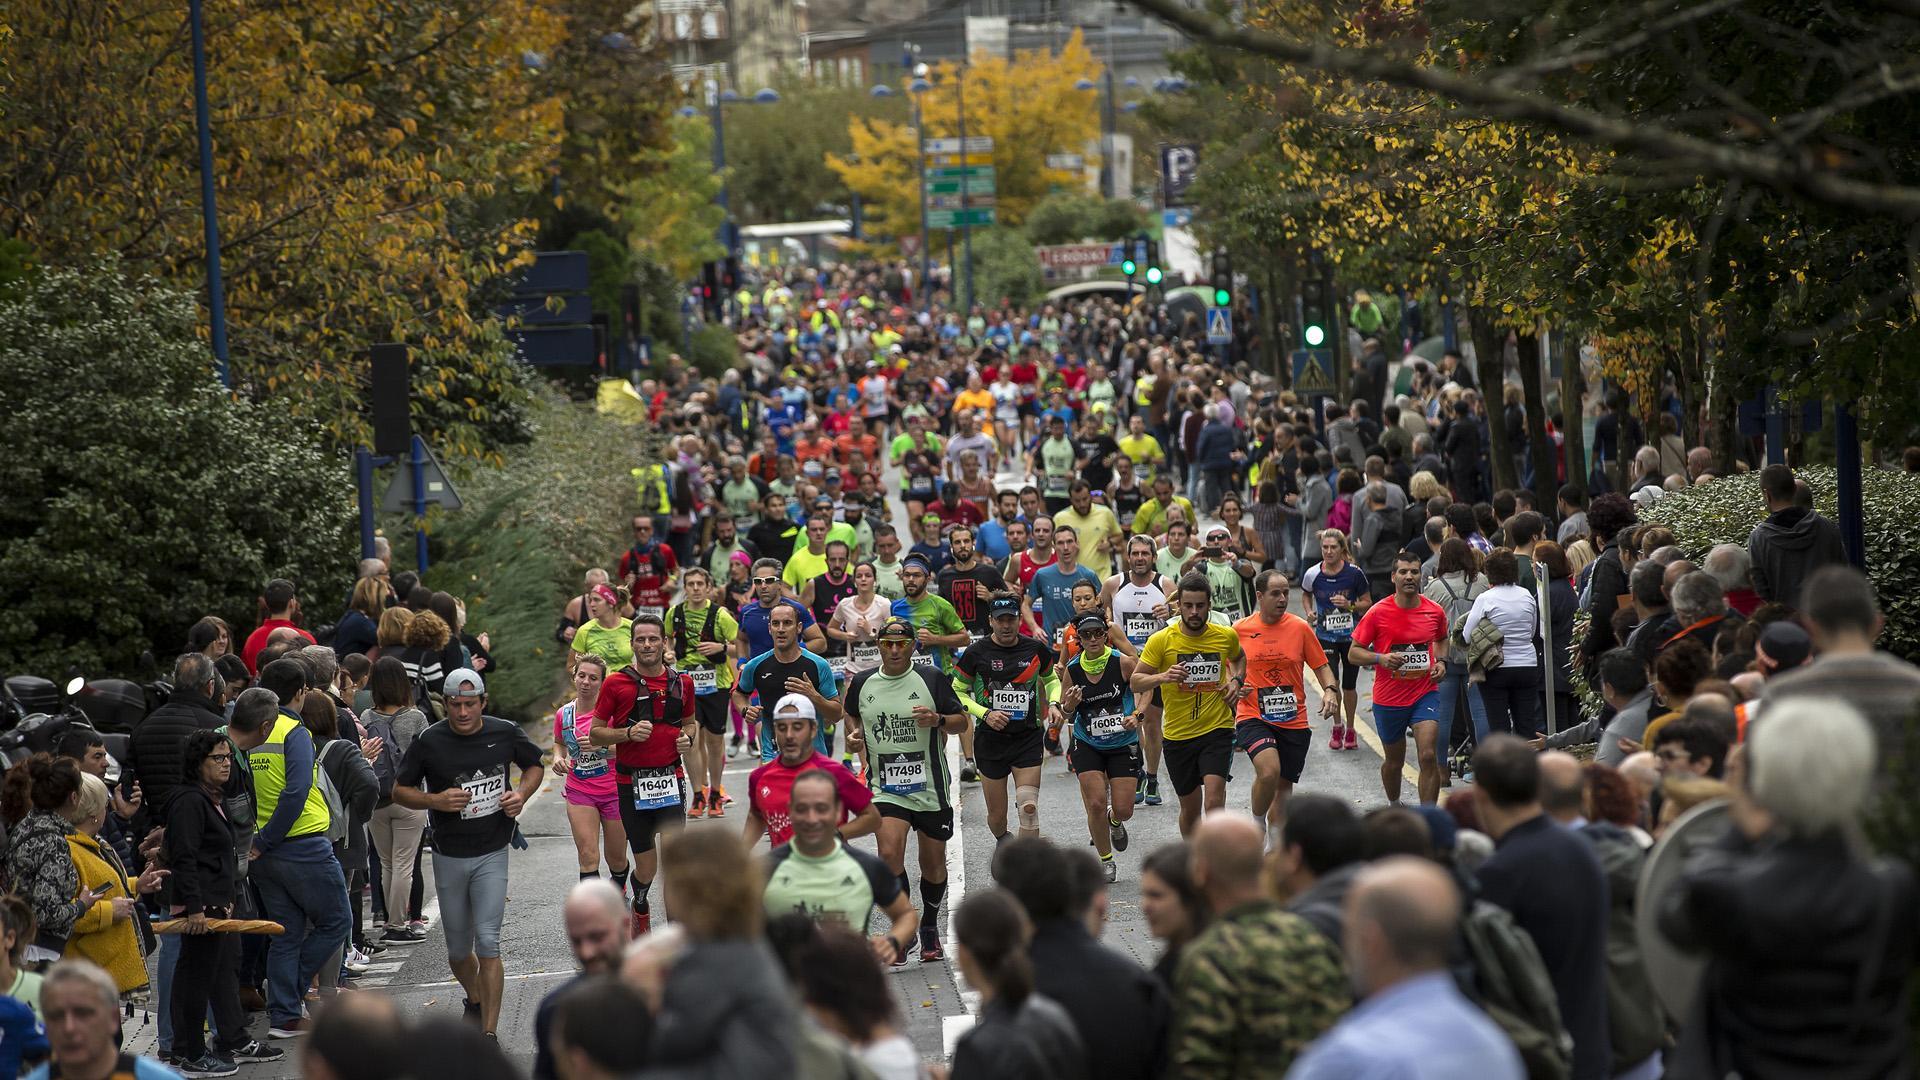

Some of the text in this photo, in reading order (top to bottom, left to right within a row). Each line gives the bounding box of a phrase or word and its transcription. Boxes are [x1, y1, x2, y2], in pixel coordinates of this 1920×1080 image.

[1167, 147, 1196, 183] P
[955, 592, 973, 622] 36
[1129, 621, 1155, 630] 15411
[855, 648, 879, 657] 20889
[1184, 664, 1219, 675] 20976
[995, 693, 1026, 704] 16013
[891, 720, 915, 729] EGINEZ
[1092, 717, 1122, 729] 16083
[892, 728, 917, 737] ALDATU
[886, 764, 922, 777] 17498
[640, 778, 674, 791] 16401
[647, 791, 670, 799] THIERRY
